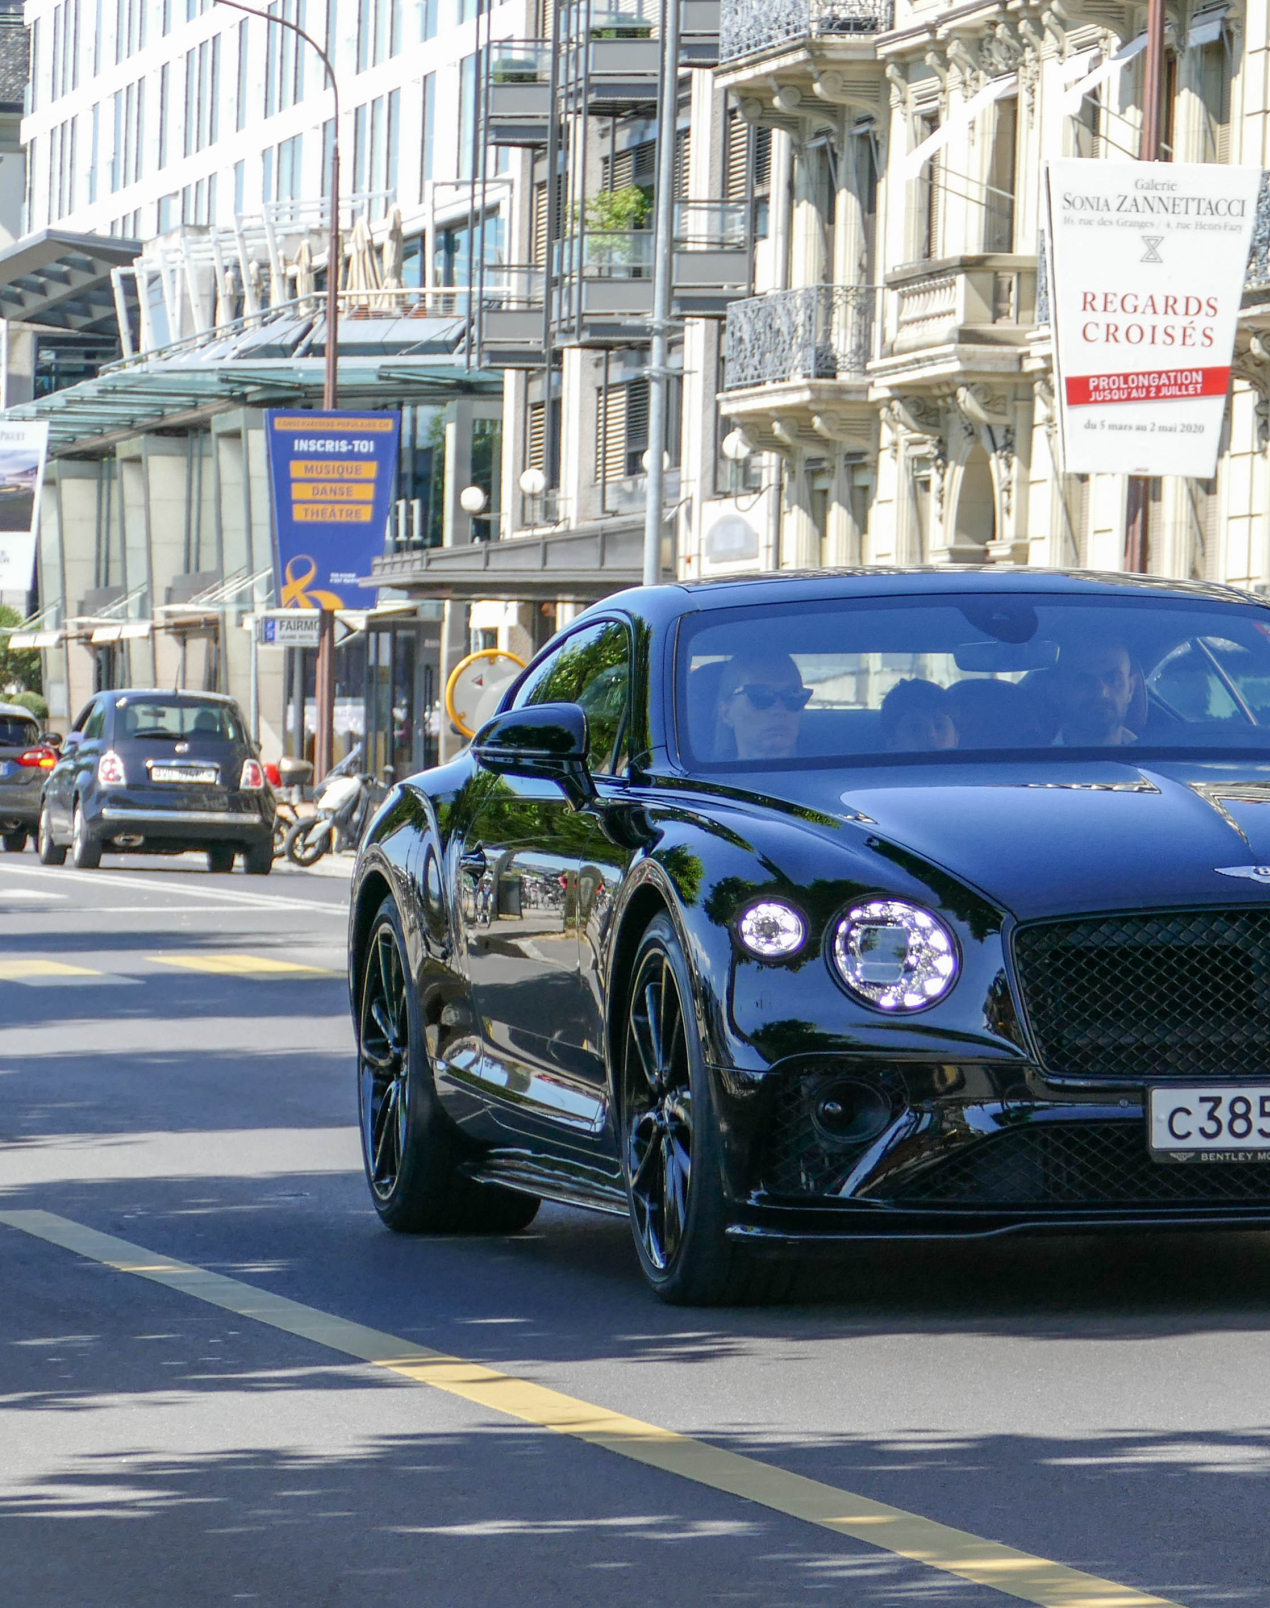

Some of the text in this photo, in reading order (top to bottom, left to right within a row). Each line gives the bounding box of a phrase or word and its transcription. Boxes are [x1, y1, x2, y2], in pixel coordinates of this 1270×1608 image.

[1134, 178, 1178, 192] Galerie
[1116, 194, 1246, 218] ZANNETTACCI
[1097, 217, 1113, 227] des
[1116, 218, 1155, 230] Granges
[1176, 222, 1192, 230] rue
[1080, 290, 1219, 319] REGARDS
[1082, 320, 1215, 349] CROISÉS
[1088, 370, 1203, 391] PROLONGATION
[1089, 384, 1203, 402] JUSQU'AU 2 JUILLET
[1084, 419, 1205, 434] du 5 mars au 2 mai 2020
[293, 438, 375, 453] INSCRIS-TOI
[304, 464, 363, 478] MUSIQUE
[312, 485, 354, 498] DANSE
[1200, 1152, 1253, 1162] BENTLEY
